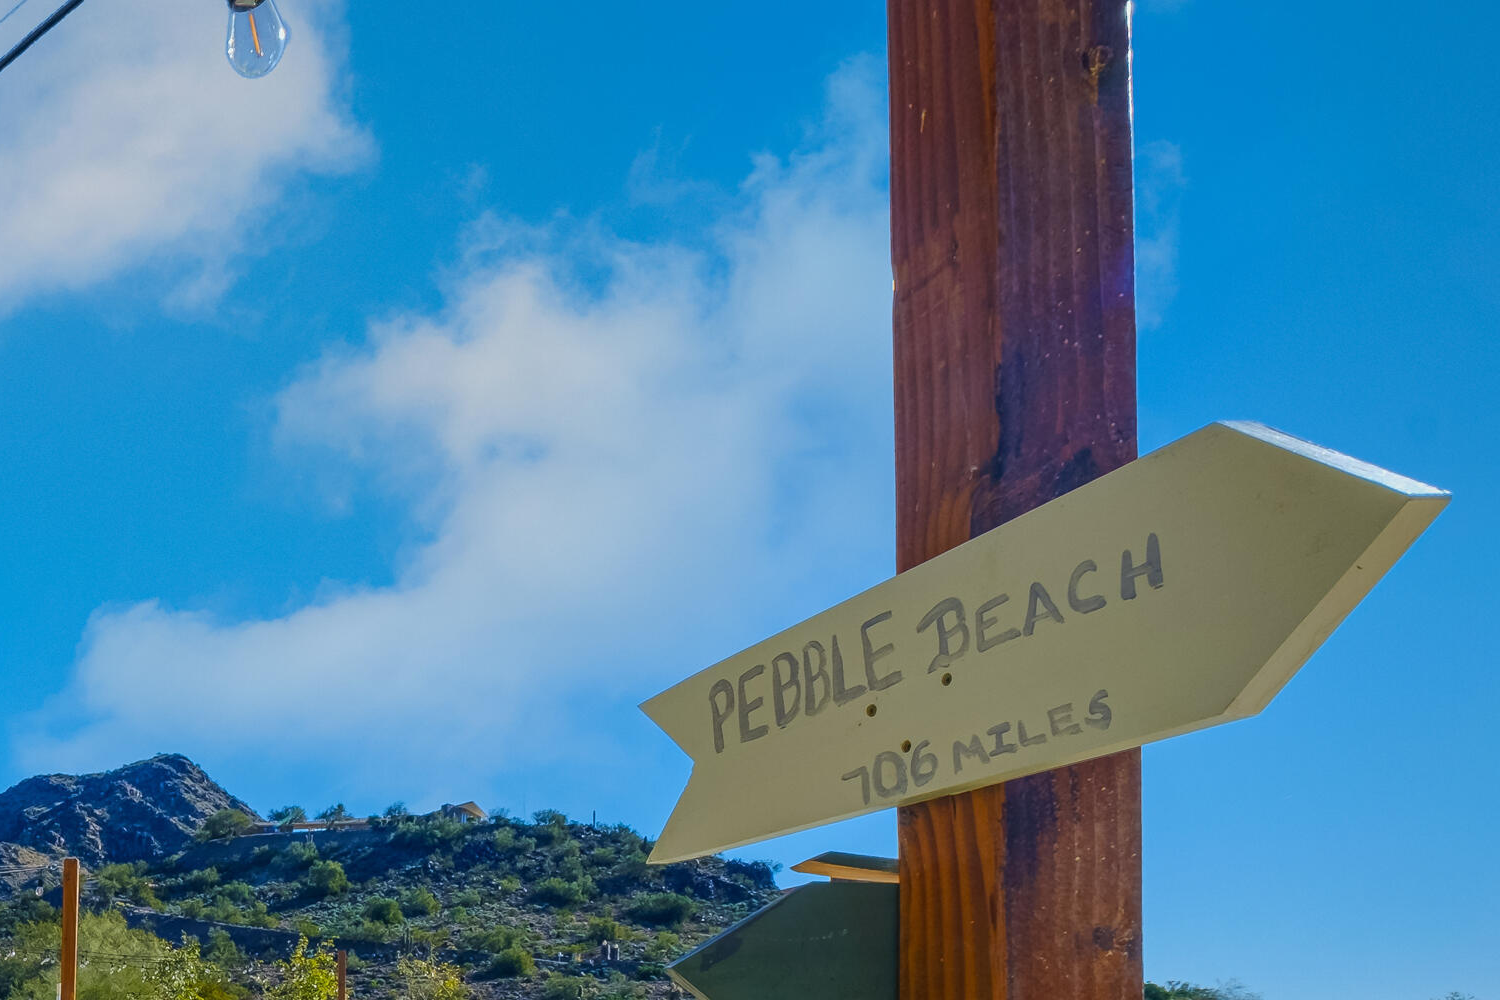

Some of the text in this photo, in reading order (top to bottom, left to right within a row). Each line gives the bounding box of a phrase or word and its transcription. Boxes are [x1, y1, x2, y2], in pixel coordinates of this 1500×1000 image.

[709, 533, 1164, 754] PEBBLE BEACH
[841, 688, 1112, 805] 706 MILES
